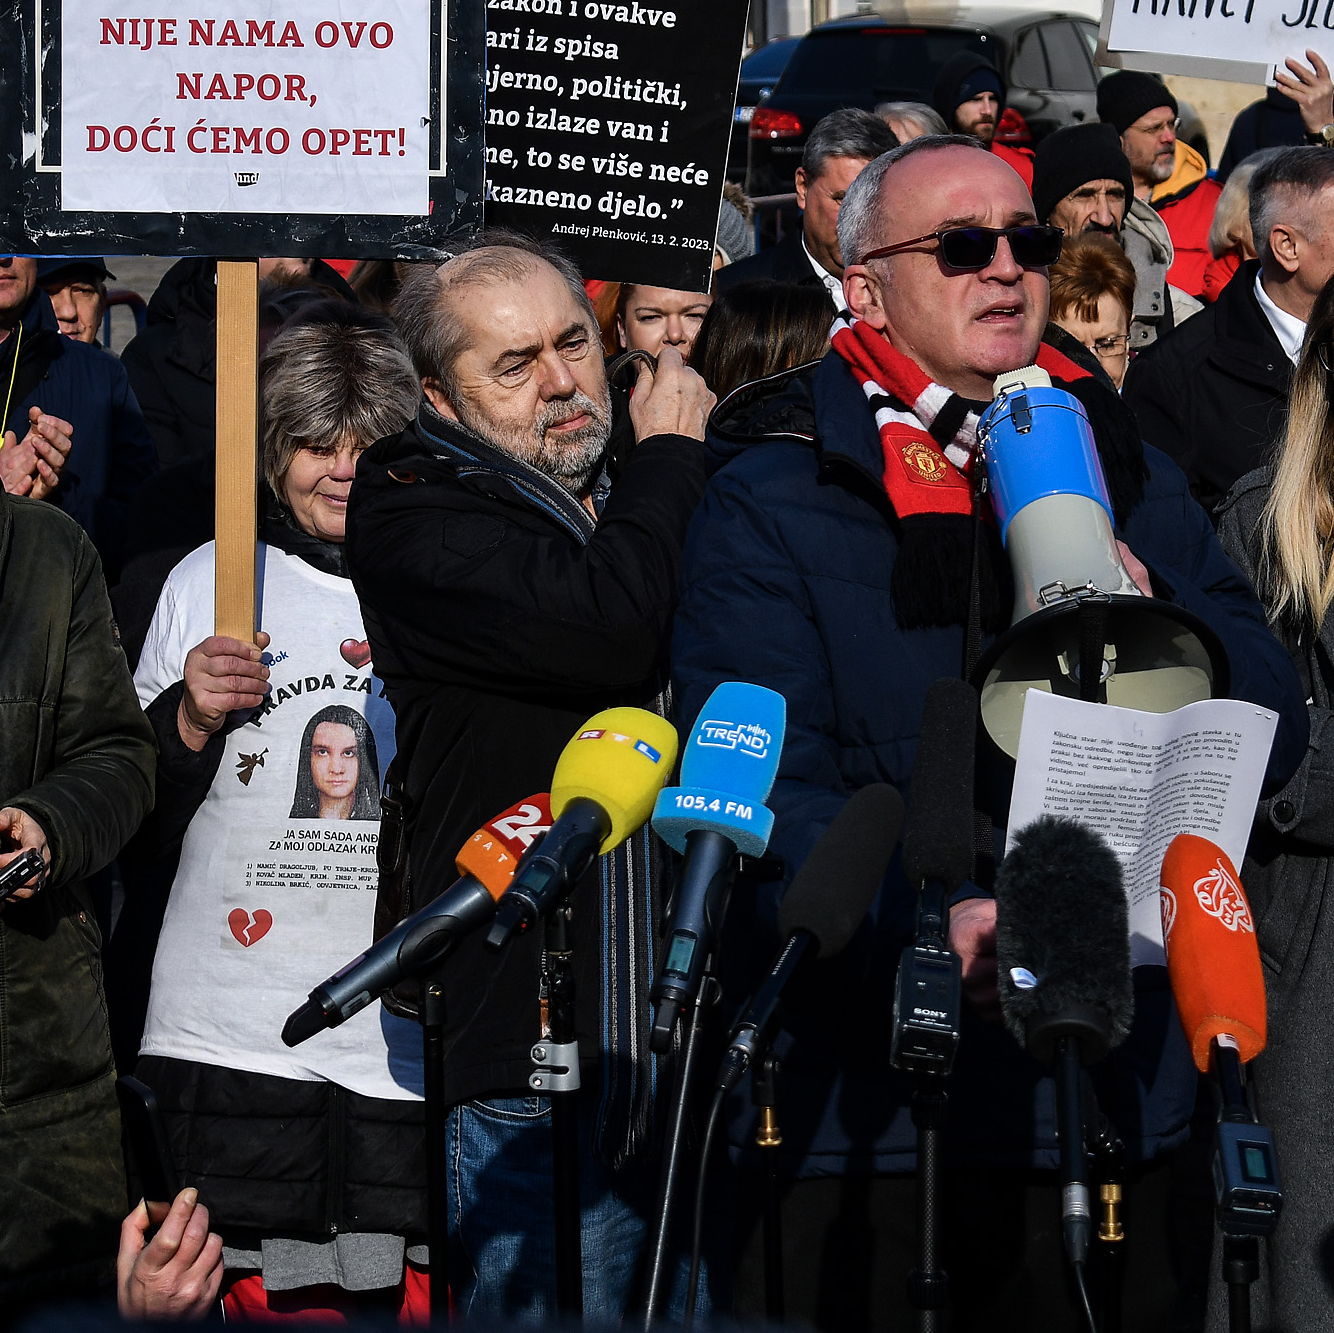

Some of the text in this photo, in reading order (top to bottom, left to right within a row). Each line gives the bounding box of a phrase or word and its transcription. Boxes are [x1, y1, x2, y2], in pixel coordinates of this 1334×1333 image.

[584, 1, 676, 28] ovakve
[100, 18, 394, 51] NIJE NAMA OVO
[525, 28, 549, 52] iz
[553, 34, 619, 61] spisa
[176, 73, 317, 107] NAPOR,
[569, 75, 687, 111] politički,
[86, 117, 406, 157] DOĆI ĆEMO OPET!
[525, 105, 600, 135] izlaze
[606, 120, 654, 141] van
[659, 120, 669, 143] i
[526, 147, 552, 168] to
[558, 153, 586, 171] se
[591, 152, 643, 178] više
[648, 162, 709, 186] neće
[485, 179, 592, 210] kazneno
[551, 223, 712, 251] Andrej Plenković, 13. 2. 2023.
[247, 674, 372, 728] PRAVDA ZA
[578, 730, 657, 761] RTL
[705, 726, 765, 750] TREND
[725, 801, 753, 820] FM
[269, 841, 281, 850] ZA
[284, 841, 304, 851] MOJ
[307, 842, 357, 853] ODLAZAK
[284, 830, 295, 839] JA
[298, 830, 322, 840] SAM
[323, 831, 352, 841] SADA
[913, 1007, 947, 1018] SONY
